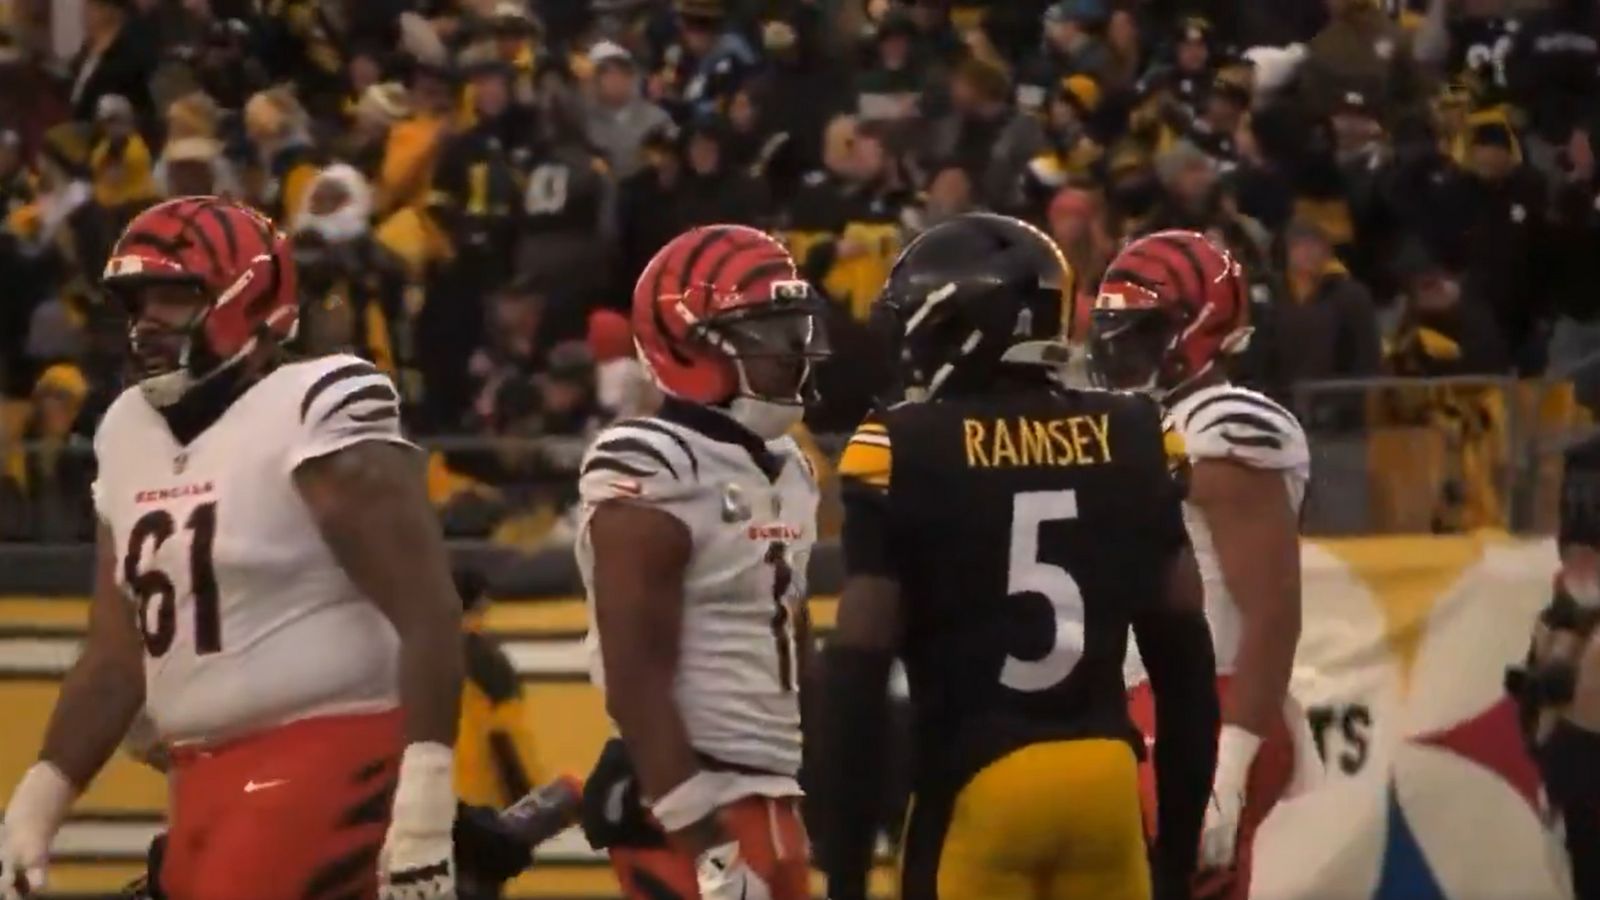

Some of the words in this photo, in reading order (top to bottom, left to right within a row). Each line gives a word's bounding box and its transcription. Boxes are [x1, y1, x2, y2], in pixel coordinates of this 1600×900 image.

[962, 412, 1112, 467] RAMSEY
[124, 500, 222, 658] 61
[998, 488, 1085, 693] 5
